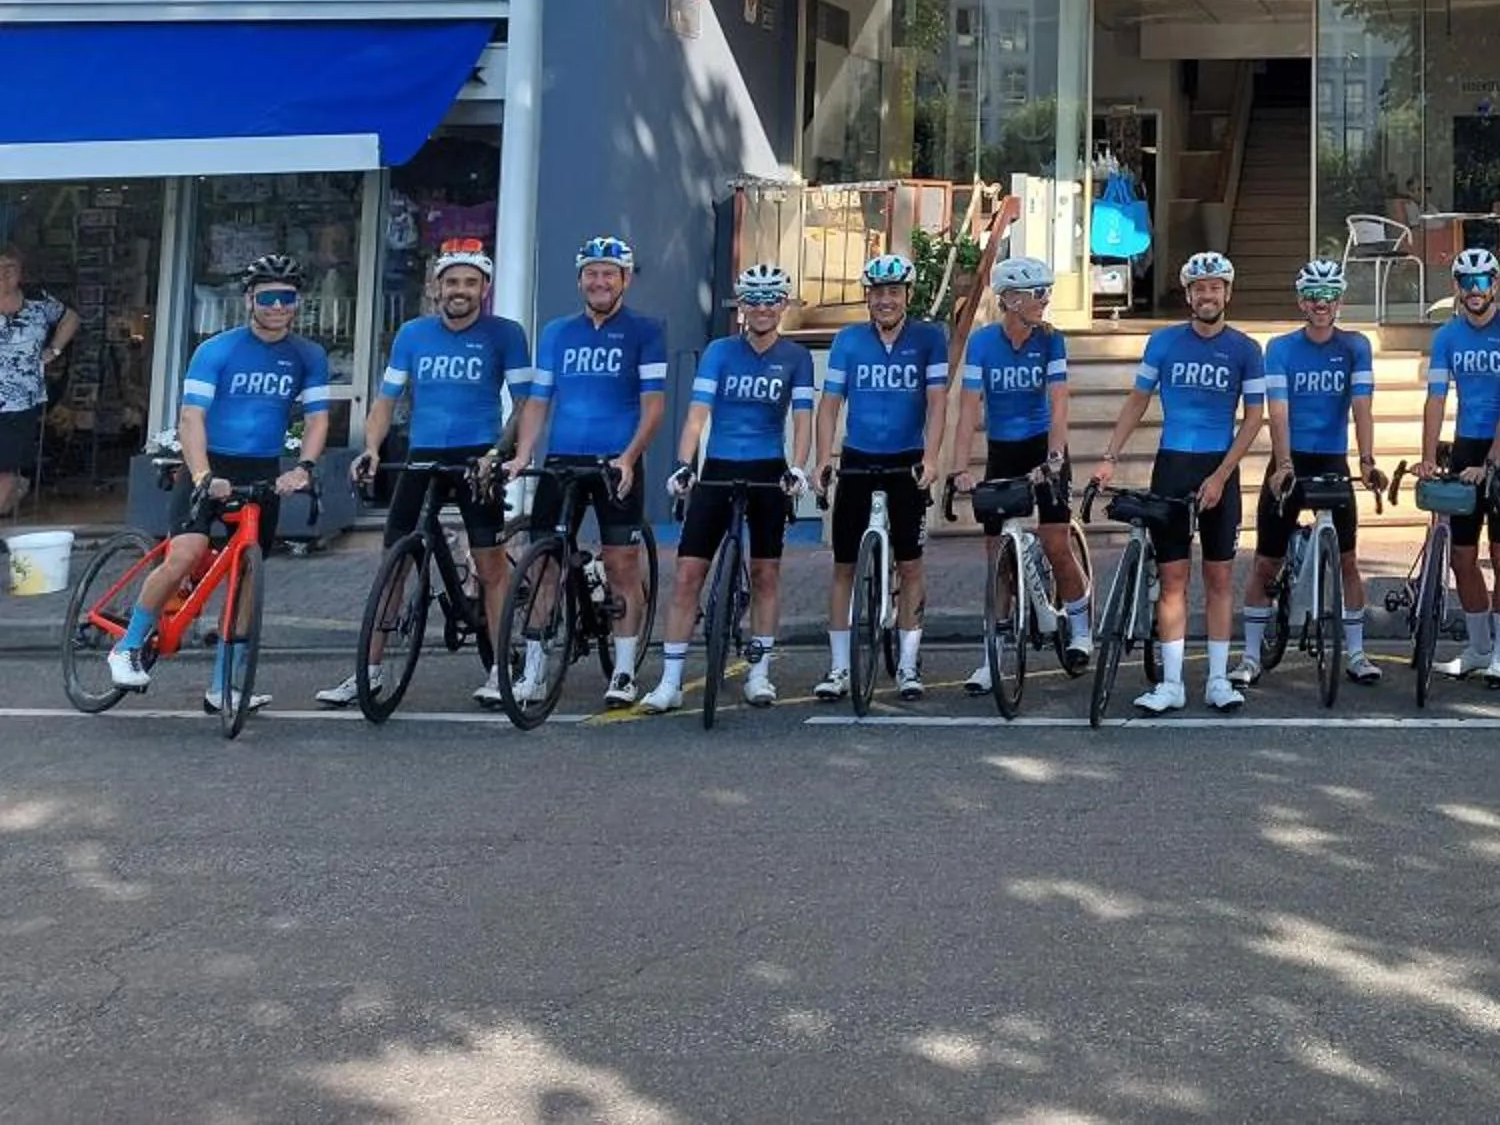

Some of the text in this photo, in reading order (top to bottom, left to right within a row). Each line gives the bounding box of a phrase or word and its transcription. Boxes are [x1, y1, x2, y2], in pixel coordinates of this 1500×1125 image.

[418, 355, 481, 380] PRCC
[563, 346, 623, 373] PRCC
[229, 373, 293, 396] PRCC
[856, 364, 918, 388] PRCC
[990, 366, 1043, 390] PRCC
[1170, 362, 1230, 388] PRCC
[1294, 370, 1345, 393] PRCC
[724, 376, 783, 400] PRCC
